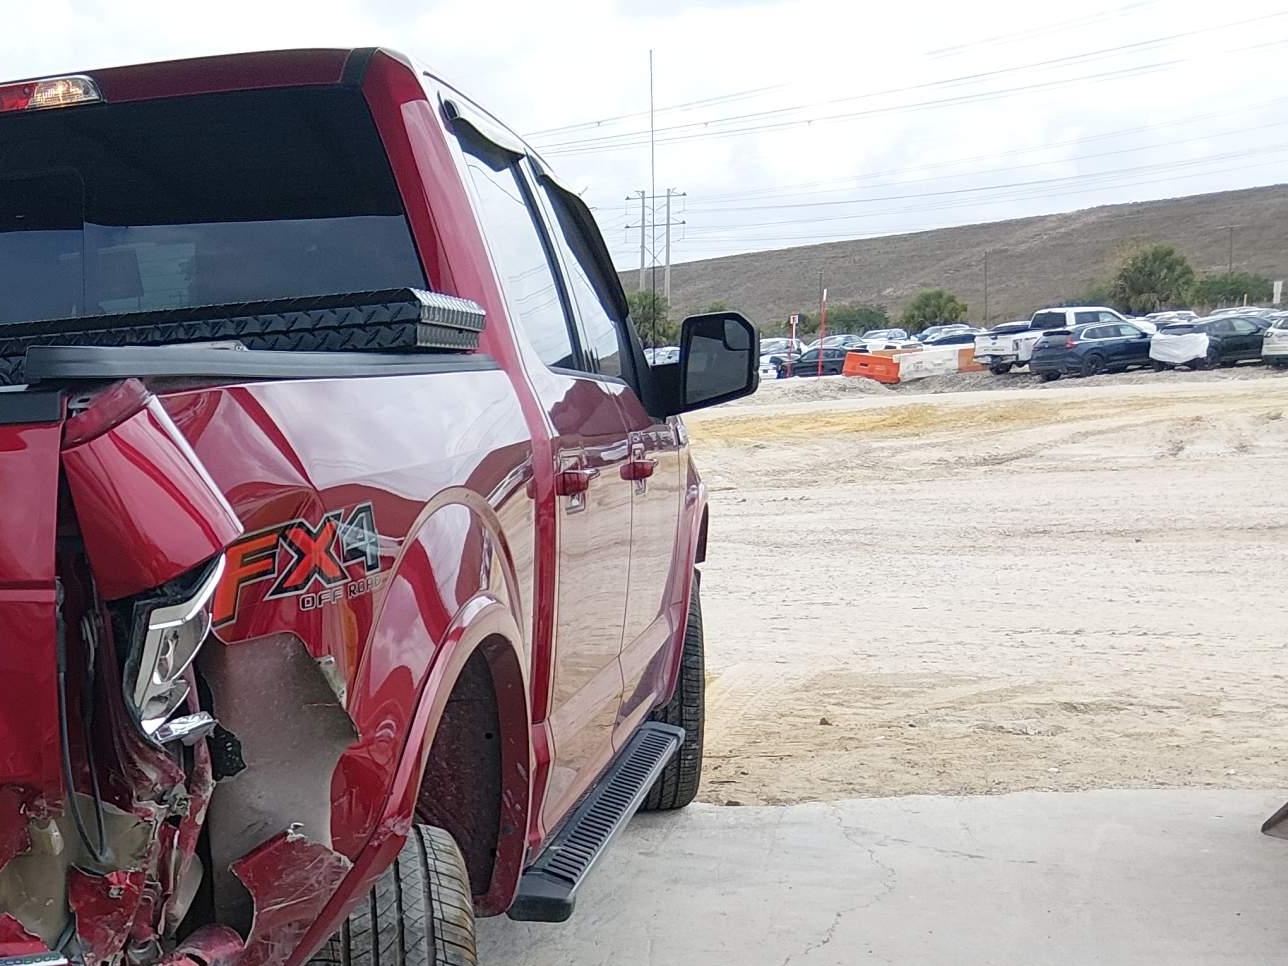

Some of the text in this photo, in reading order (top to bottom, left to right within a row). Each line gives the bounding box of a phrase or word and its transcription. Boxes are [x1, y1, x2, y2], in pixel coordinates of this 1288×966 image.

[211, 502, 380, 629] FX4
[299, 575, 382, 611] OFF ROAD
